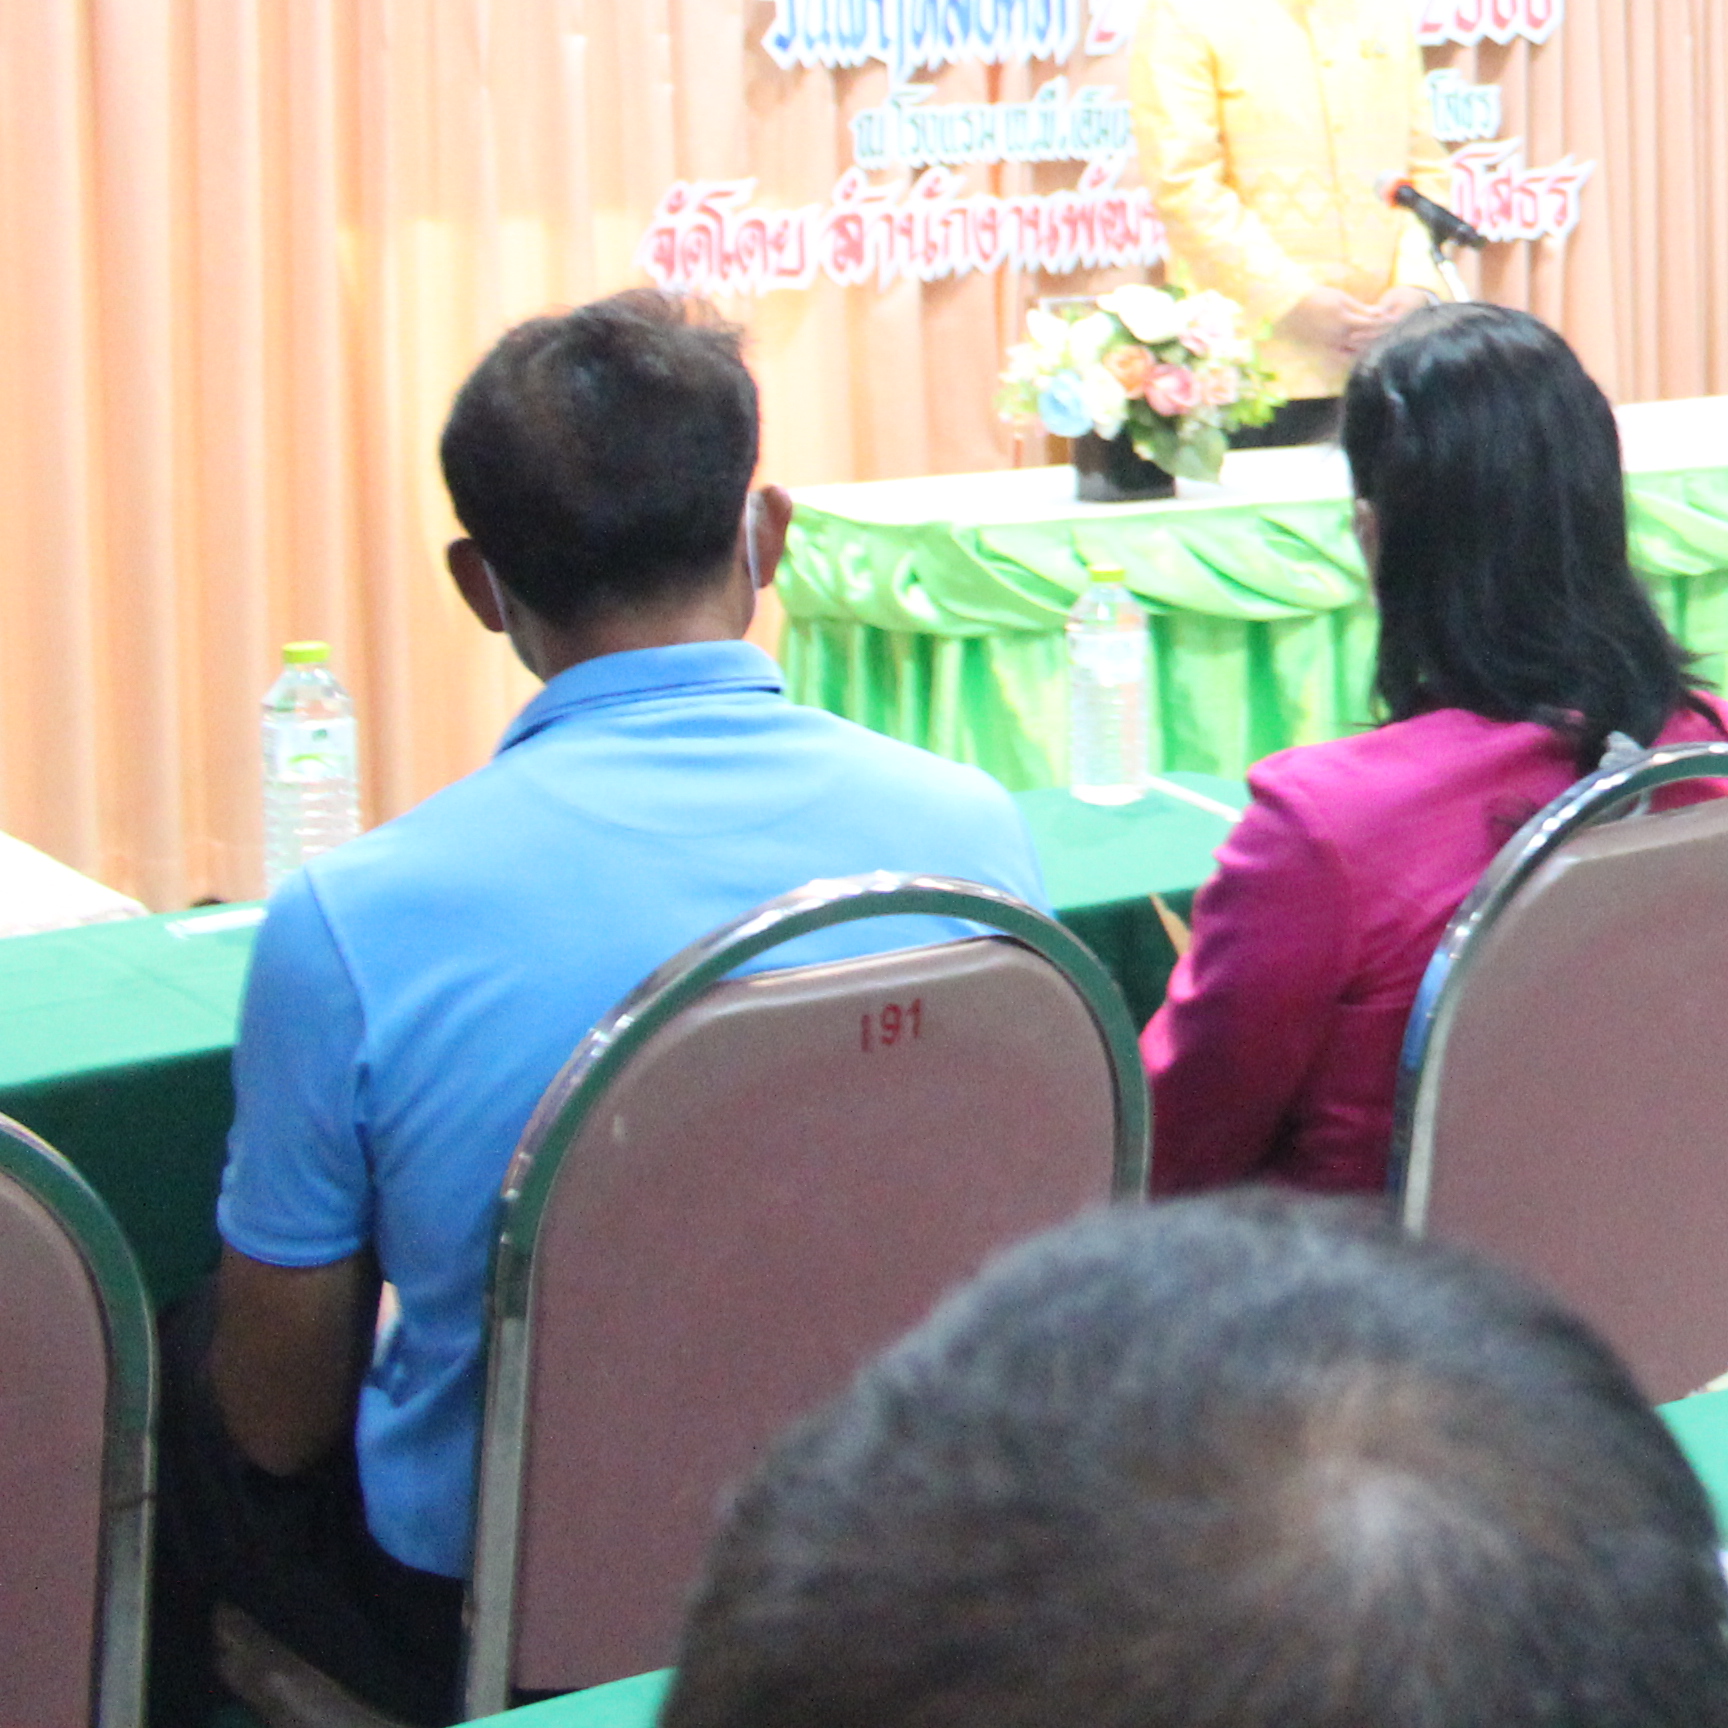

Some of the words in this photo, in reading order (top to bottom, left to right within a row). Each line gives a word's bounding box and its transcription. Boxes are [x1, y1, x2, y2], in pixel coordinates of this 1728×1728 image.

[650, 187, 808, 282] จัดโดย
[860, 997, 922, 1053] 191
